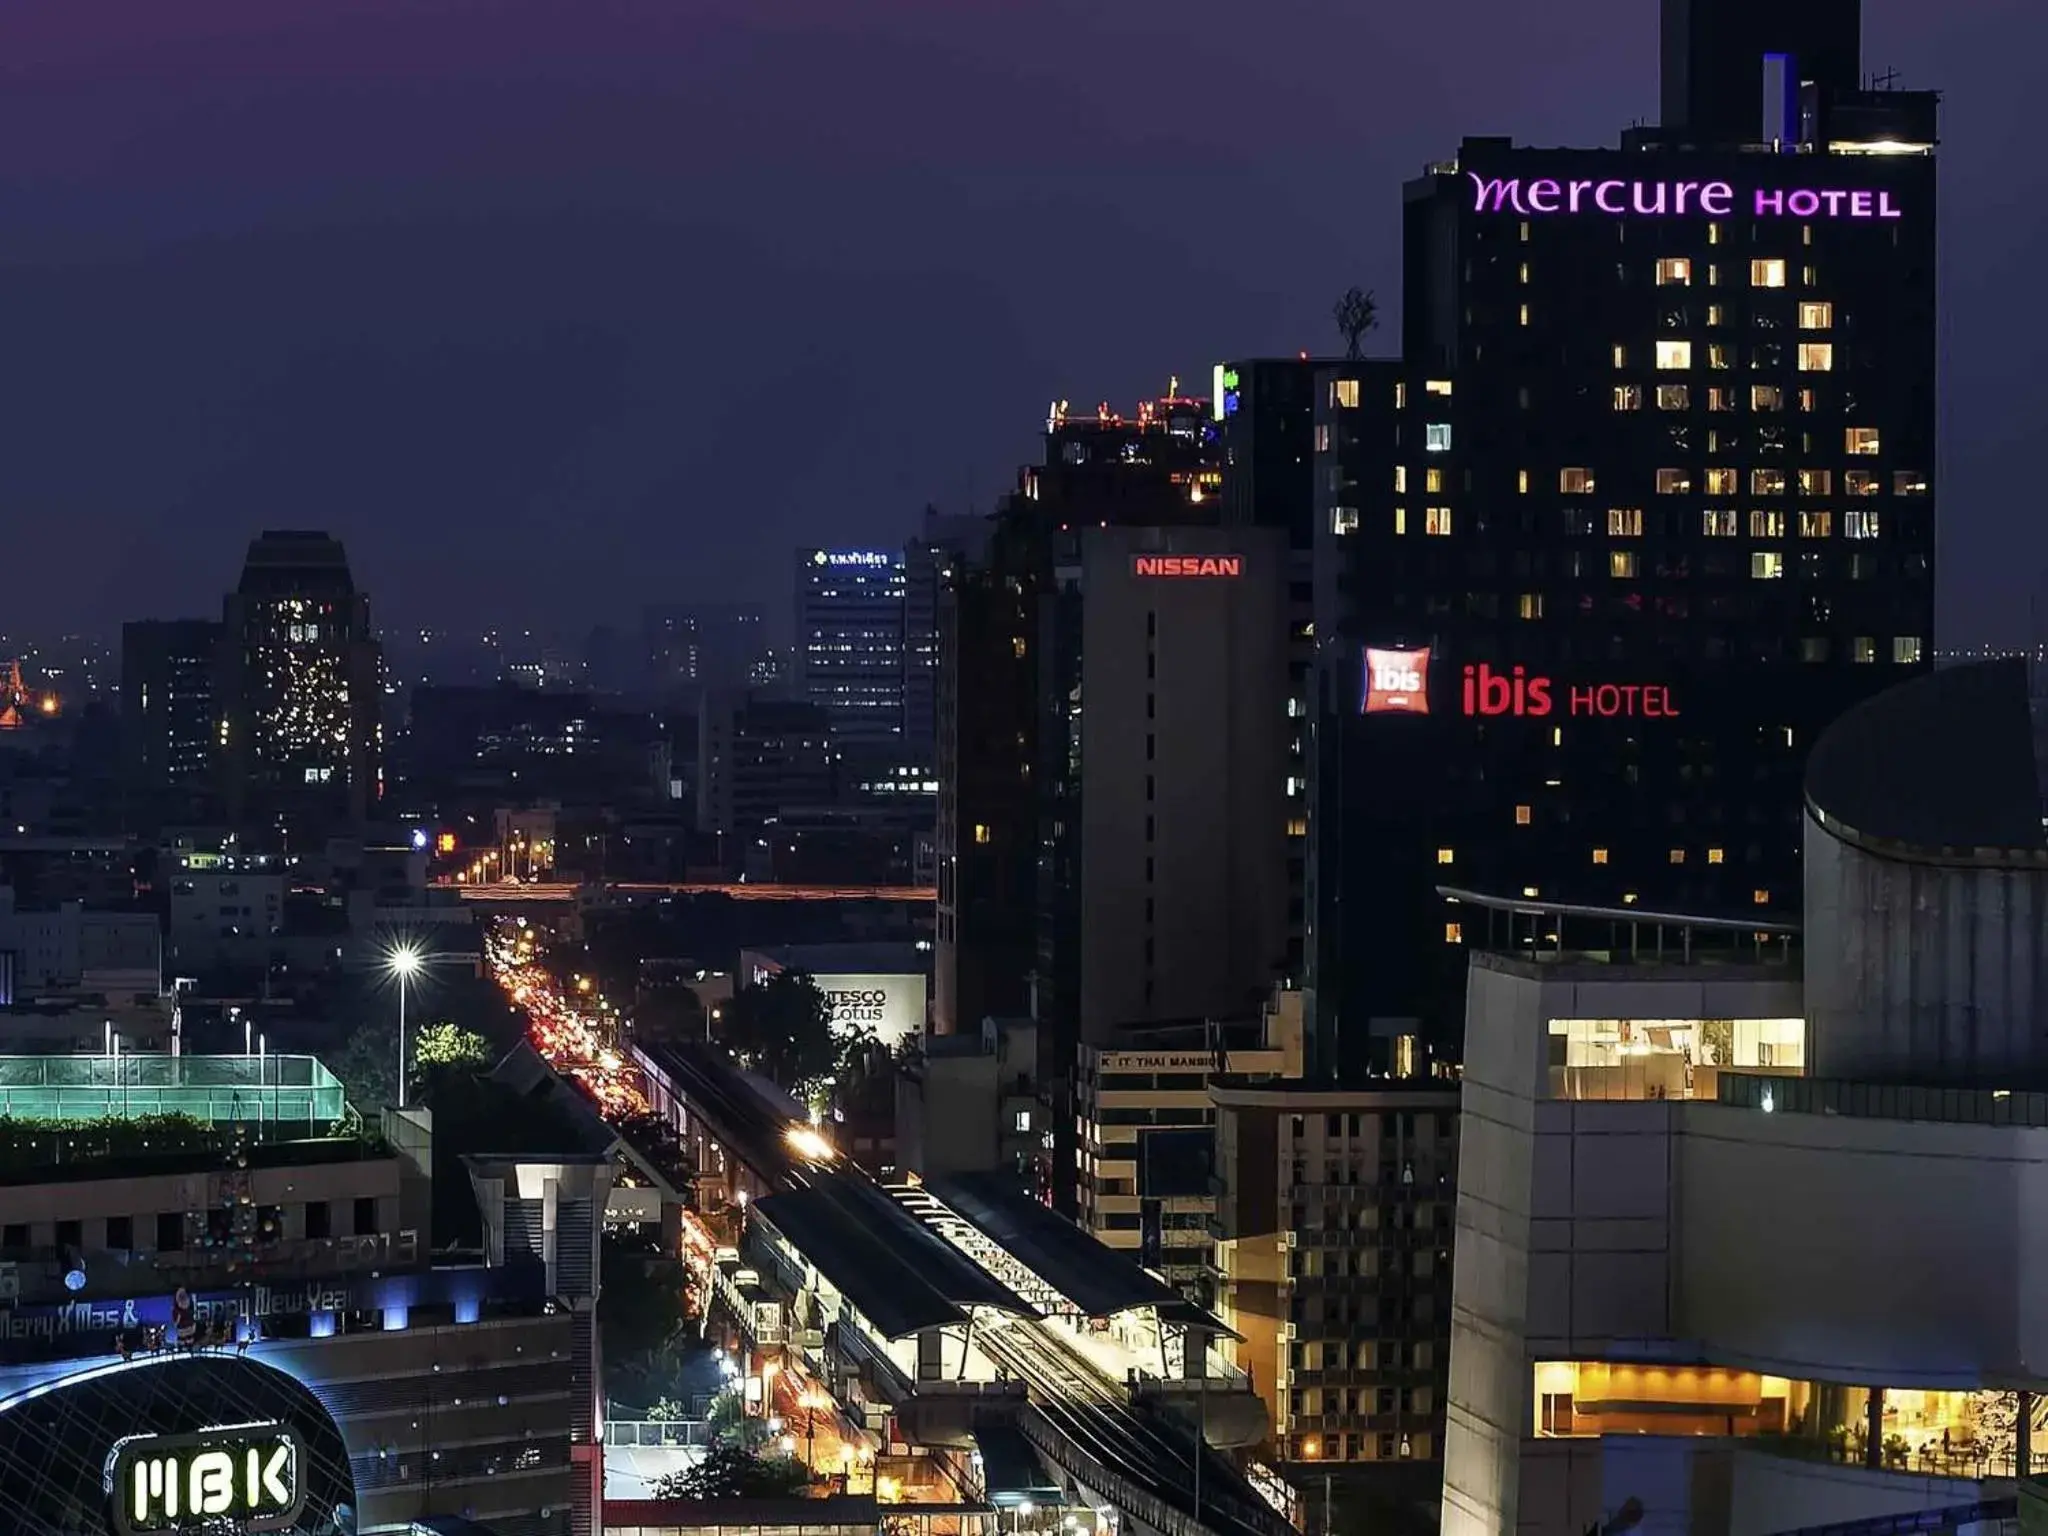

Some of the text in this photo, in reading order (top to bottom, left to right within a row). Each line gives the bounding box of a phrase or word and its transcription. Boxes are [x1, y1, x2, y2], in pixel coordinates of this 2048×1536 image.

[1467, 171, 1900, 216] mercure HOTEL
[1136, 558, 1239, 575] NISSAN
[1374, 666, 1421, 692] ibis
[1463, 664, 1681, 717] ibis HOTEL
[828, 990, 886, 1003] TESCO
[1136, 1057, 1166, 1067] THAI
[1170, 1057, 1218, 1068] MANSIO
[123, 1299, 139, 1329] &
[135, 1446, 288, 1522] MBK
